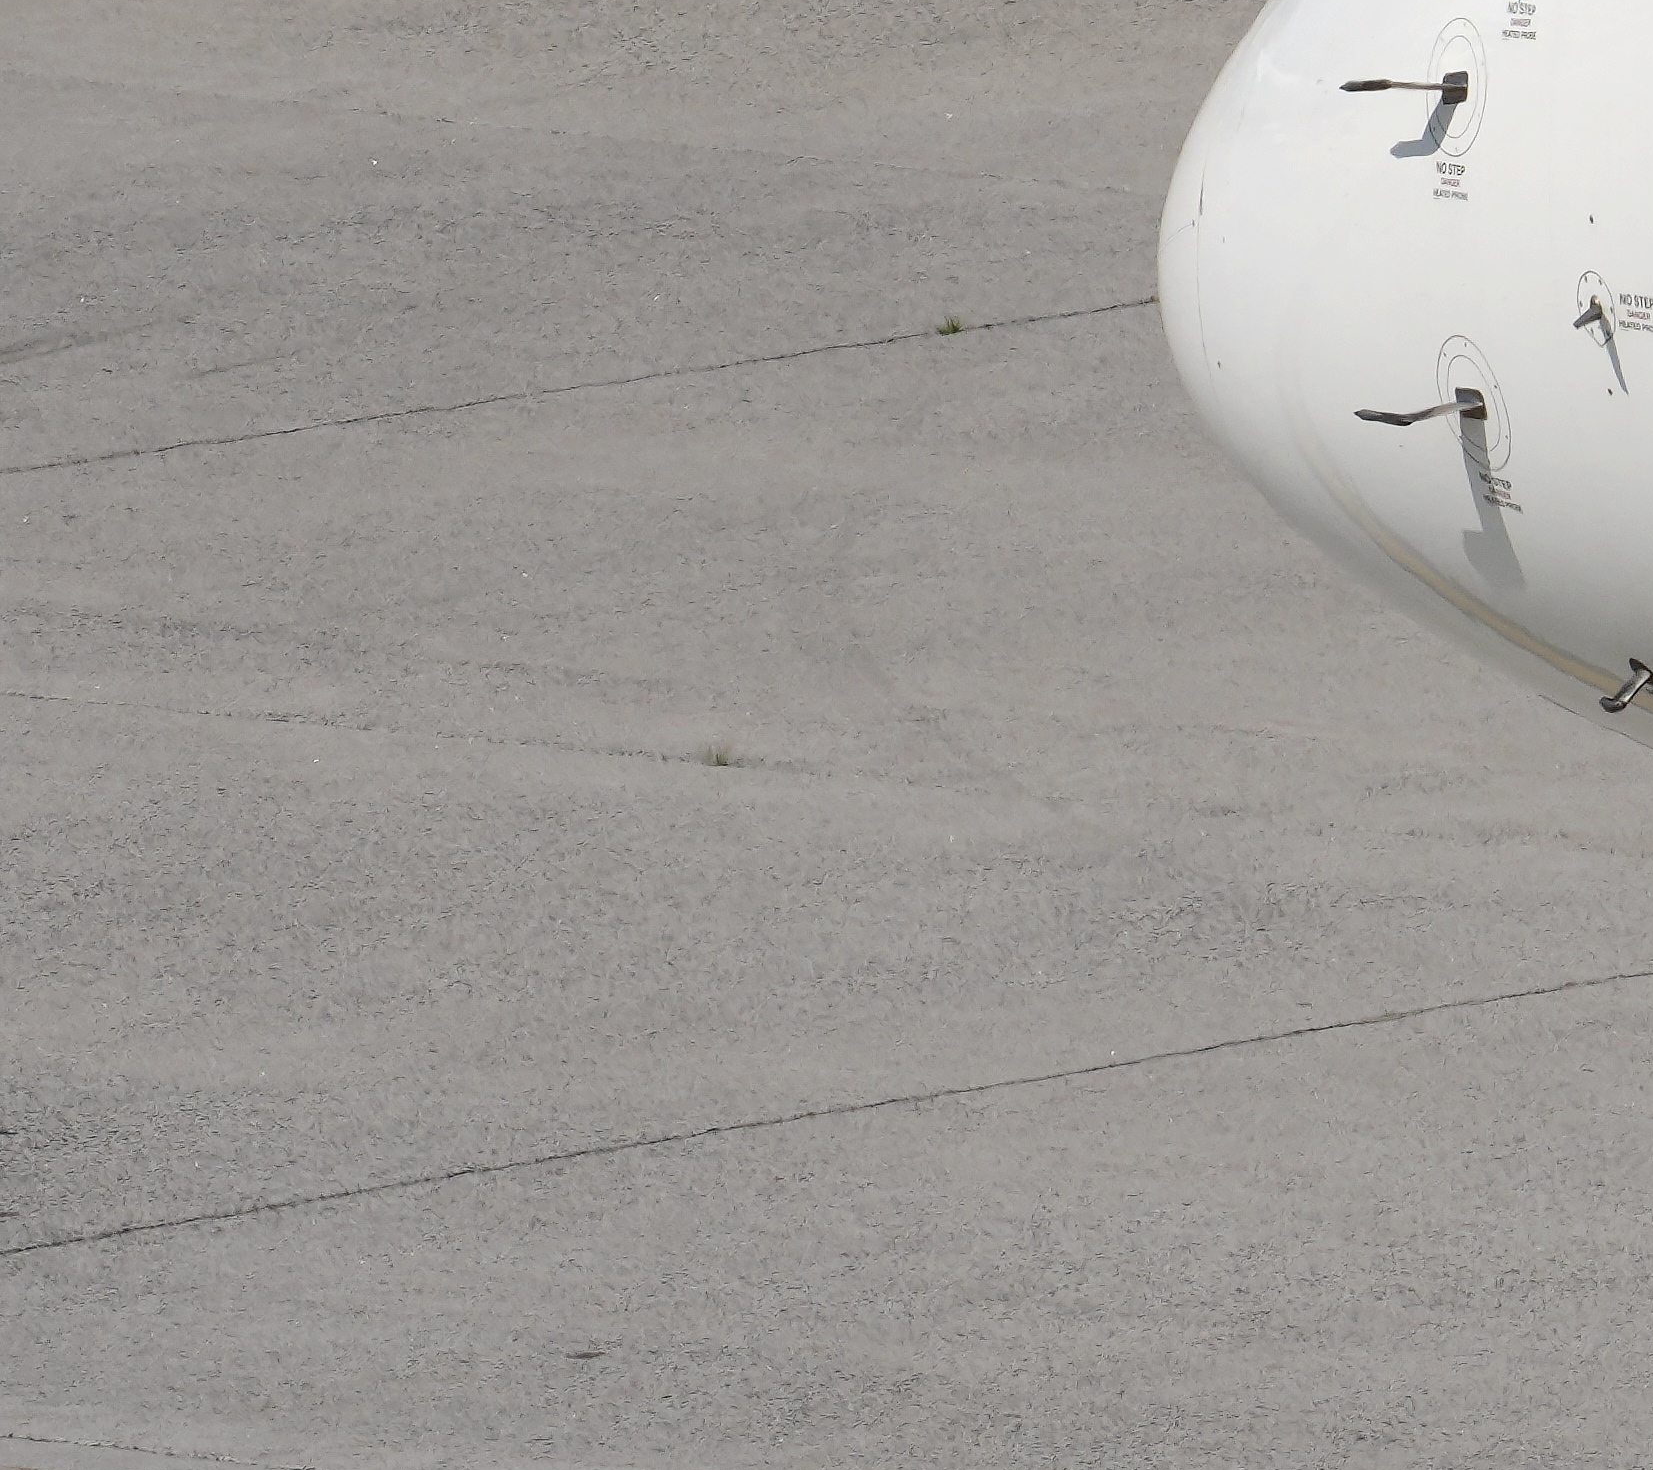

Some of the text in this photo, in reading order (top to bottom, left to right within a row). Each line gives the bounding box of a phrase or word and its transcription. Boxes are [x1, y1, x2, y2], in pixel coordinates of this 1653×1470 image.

[1508, 1, 1536, 15] NO STEP
[1436, 161, 1466, 176] NO STEP
[1620, 293, 1653, 309] NO STEP
